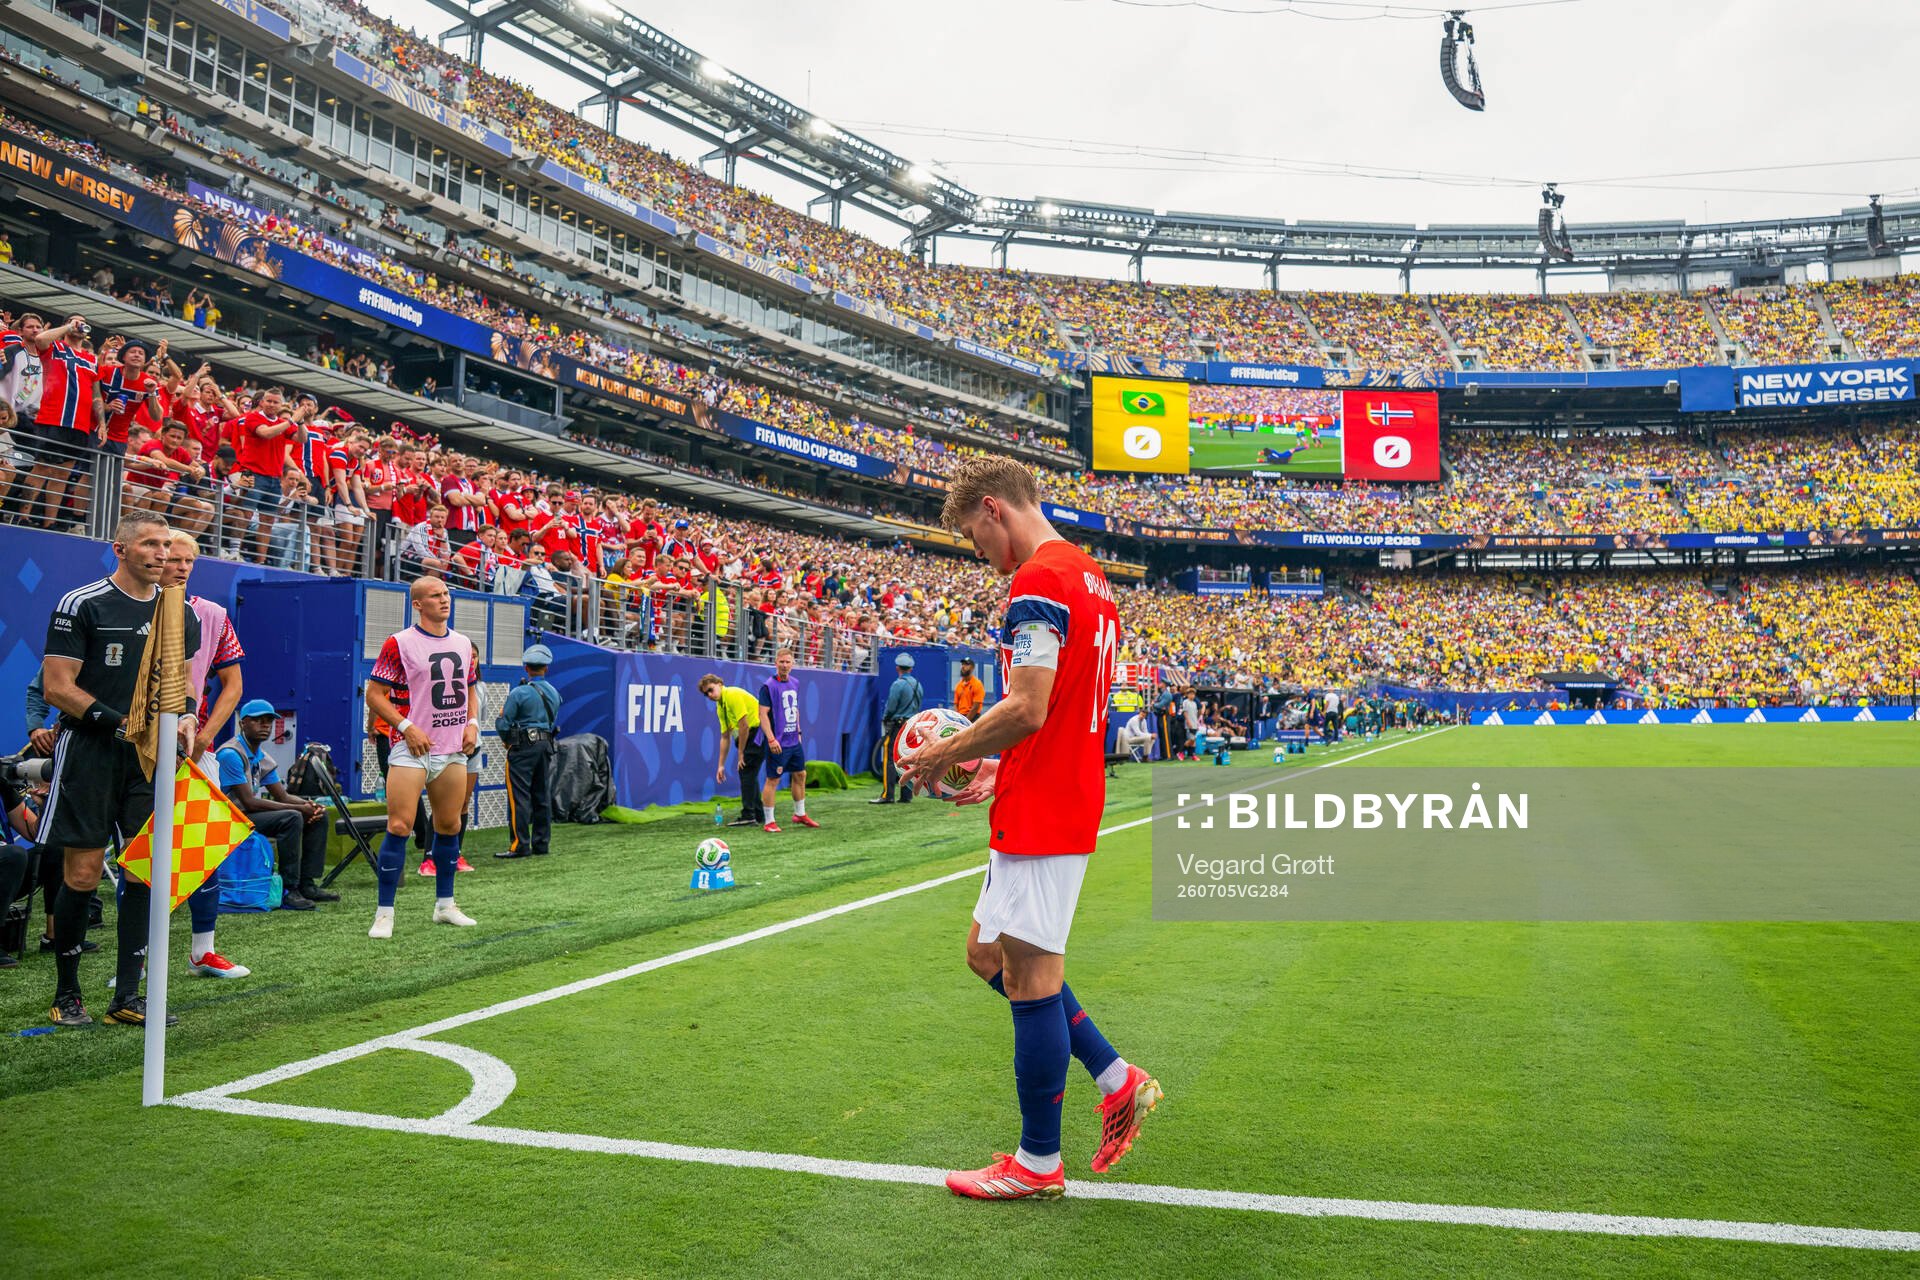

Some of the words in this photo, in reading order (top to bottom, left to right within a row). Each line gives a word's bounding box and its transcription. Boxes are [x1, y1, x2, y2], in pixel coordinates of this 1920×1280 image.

[0, 141, 53, 180] NEW
[55, 167, 135, 213] JERSEY
[205, 191, 250, 219] NEW
[323, 238, 348, 256] EW
[359, 287, 423, 327] #FIFAWorldCup
[1230, 366, 1299, 383] #FIFAWorldCup
[1742, 372, 1812, 390] NEW
[1819, 367, 1908, 386] YORK
[576, 367, 599, 388] NEW
[600, 376, 627, 397] YORK
[628, 386, 651, 404] NEW
[651, 394, 686, 416] JERSEY
[1743, 391, 1800, 406] NEW
[1806, 386, 1908, 403] JERSEY
[755, 427, 777, 446] FIFA
[777, 432, 810, 455] WORLD
[810, 442, 828, 460] CUP
[828, 450, 857, 468] 2026
[1252, 470, 1281, 478] Hisense
[1175, 531, 1195, 539] NEW
[1302, 534, 1326, 545] FIFA
[1326, 534, 1363, 545] WORLD
[1363, 535, 1385, 545] CUP
[1384, 536, 1422, 546] 2026
[1495, 538, 1515, 546] NEW
[1516, 538, 1540, 546] YORK
[1541, 538, 1562, 546] NEW
[1562, 538, 1596, 546] JERSEY
[1882, 531, 1904, 540] NEW
[55, 617, 72, 628] FIFA
[442, 697, 457, 705] FIFA
[628, 684, 684, 734] FIFA
[432, 711, 454, 719] WORLD
[454, 709, 467, 717] CUP
[432, 716, 467, 728] 2026
